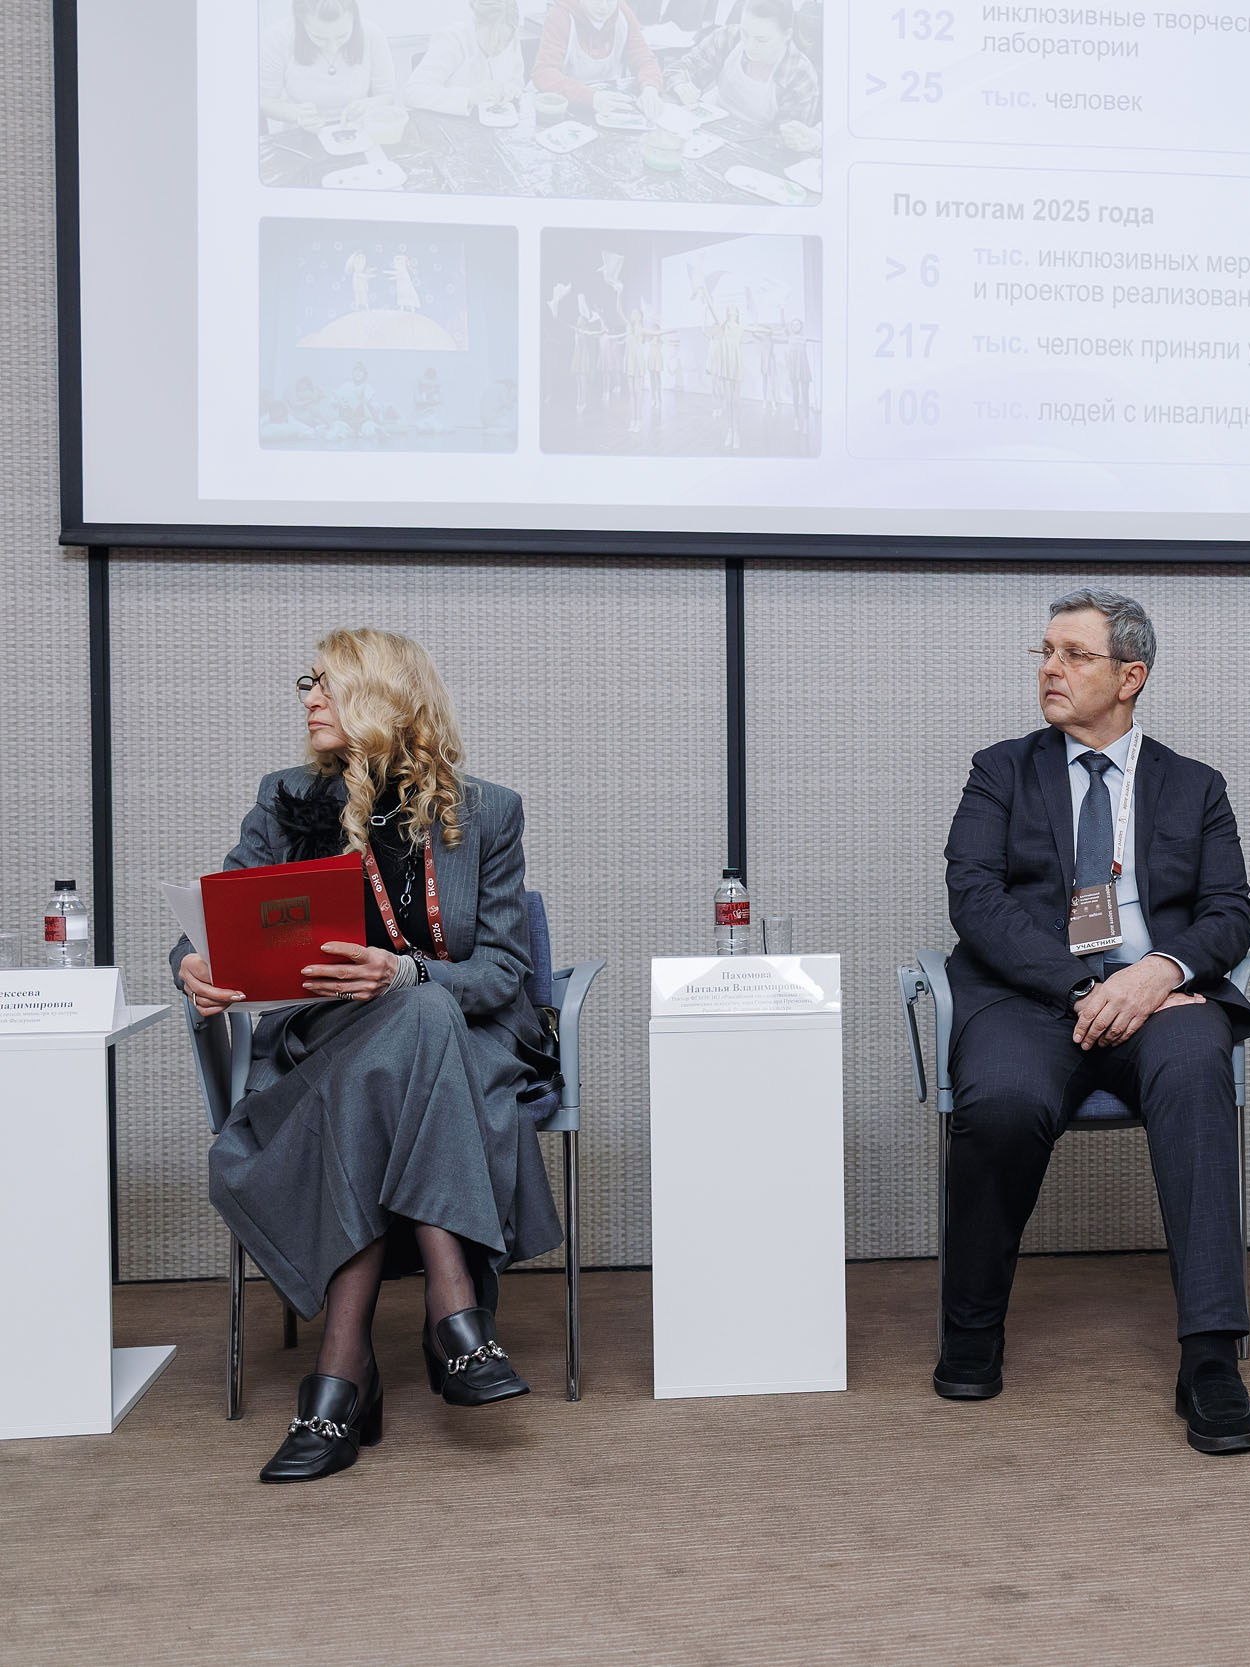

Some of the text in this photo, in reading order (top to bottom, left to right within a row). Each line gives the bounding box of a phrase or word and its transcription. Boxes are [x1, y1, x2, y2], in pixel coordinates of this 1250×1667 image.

[891, 8, 954, 41] 132
[983, 5, 1146, 27] инклюзивные
[981, 32, 1138, 61] лаборатории
[900, 70, 943, 103] 25
[981, 90, 1142, 111] тыс. человек
[894, 193, 1154, 228] По итогам 2025 года
[920, 254, 940, 288] 6
[973, 248, 1029, 267] тыс.
[1039, 250, 1199, 272] инклюзивных
[974, 282, 986, 299] и
[996, 283, 1104, 306] проектов
[874, 322, 939, 358] 217
[972, 335, 1028, 354] тыс.
[1037, 337, 1133, 357] человек
[1141, 340, 1239, 364] приняли
[877, 389, 939, 426] 106
[973, 401, 1028, 419] тыс.
[1038, 398, 1115, 426] людей
[1124, 404, 1136, 423] с
[371, 873, 383, 893] БКФ
[427, 877, 436, 897] БКФ
[386, 918, 398, 938] БКФ
[432, 922, 443, 942] 2026
[1076, 938, 1117, 950] УЧАСТНИК
[721, 971, 772, 980] Пахомова
[686, 982, 805, 994] Наталья Владимировн
